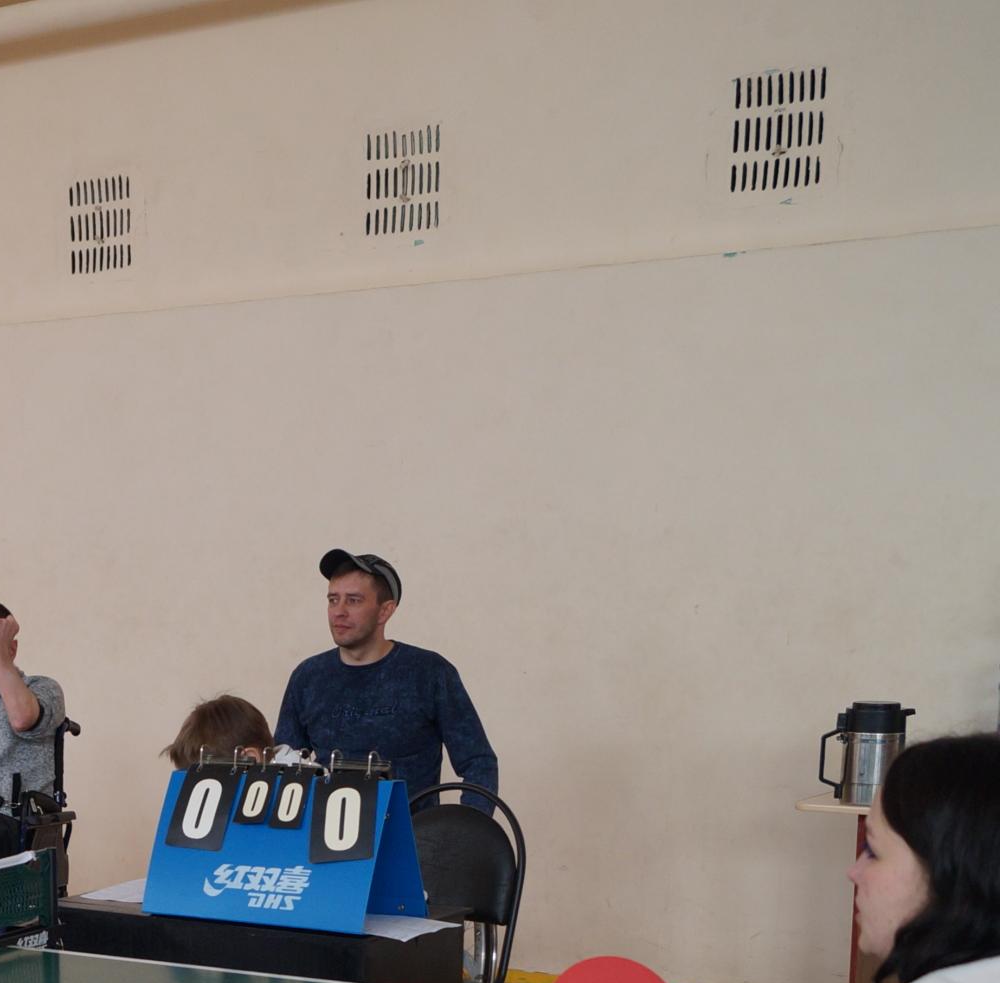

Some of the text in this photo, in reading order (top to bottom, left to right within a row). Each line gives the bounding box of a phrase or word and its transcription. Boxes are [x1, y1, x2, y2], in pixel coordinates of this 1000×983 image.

[182, 778, 361, 851] 0 0 0 0
[203, 863, 312, 897] 红双喜
[247, 892, 302, 911] DHS
